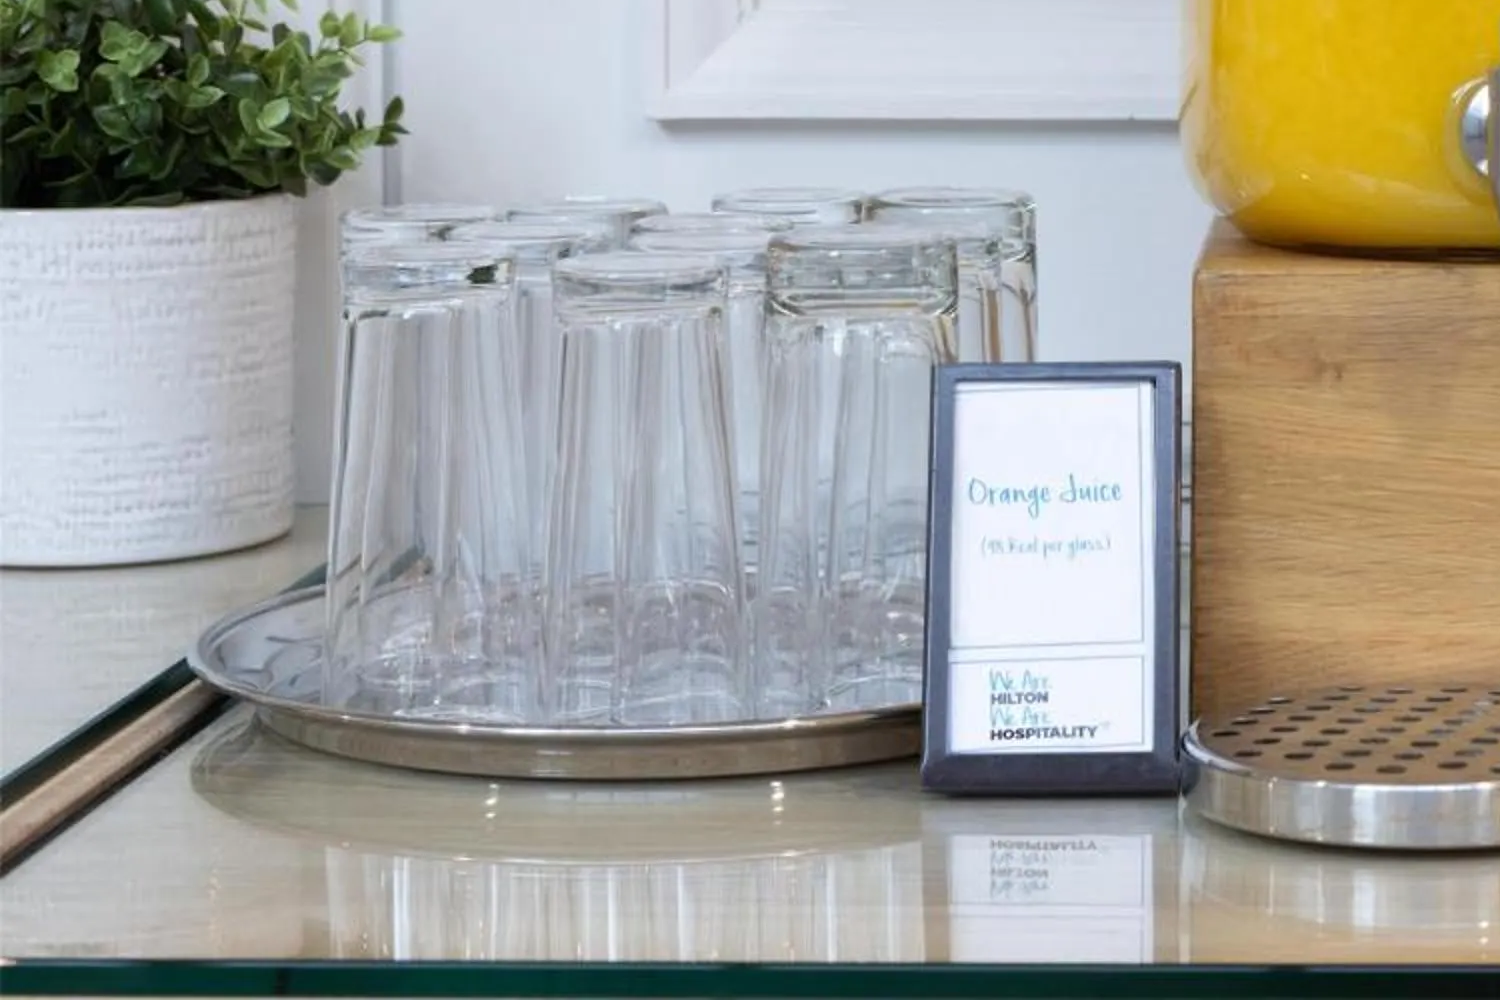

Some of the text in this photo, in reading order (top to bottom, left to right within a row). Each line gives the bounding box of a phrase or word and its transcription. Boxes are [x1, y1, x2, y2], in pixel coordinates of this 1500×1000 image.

[968, 472, 1122, 520] Orange Juice
[1042, 538, 1063, 560] per
[989, 668, 1013, 691] We
[990, 691, 1049, 705] HILTON
[989, 704, 1013, 727] We
[989, 724, 1099, 742] HOSPITALITY
